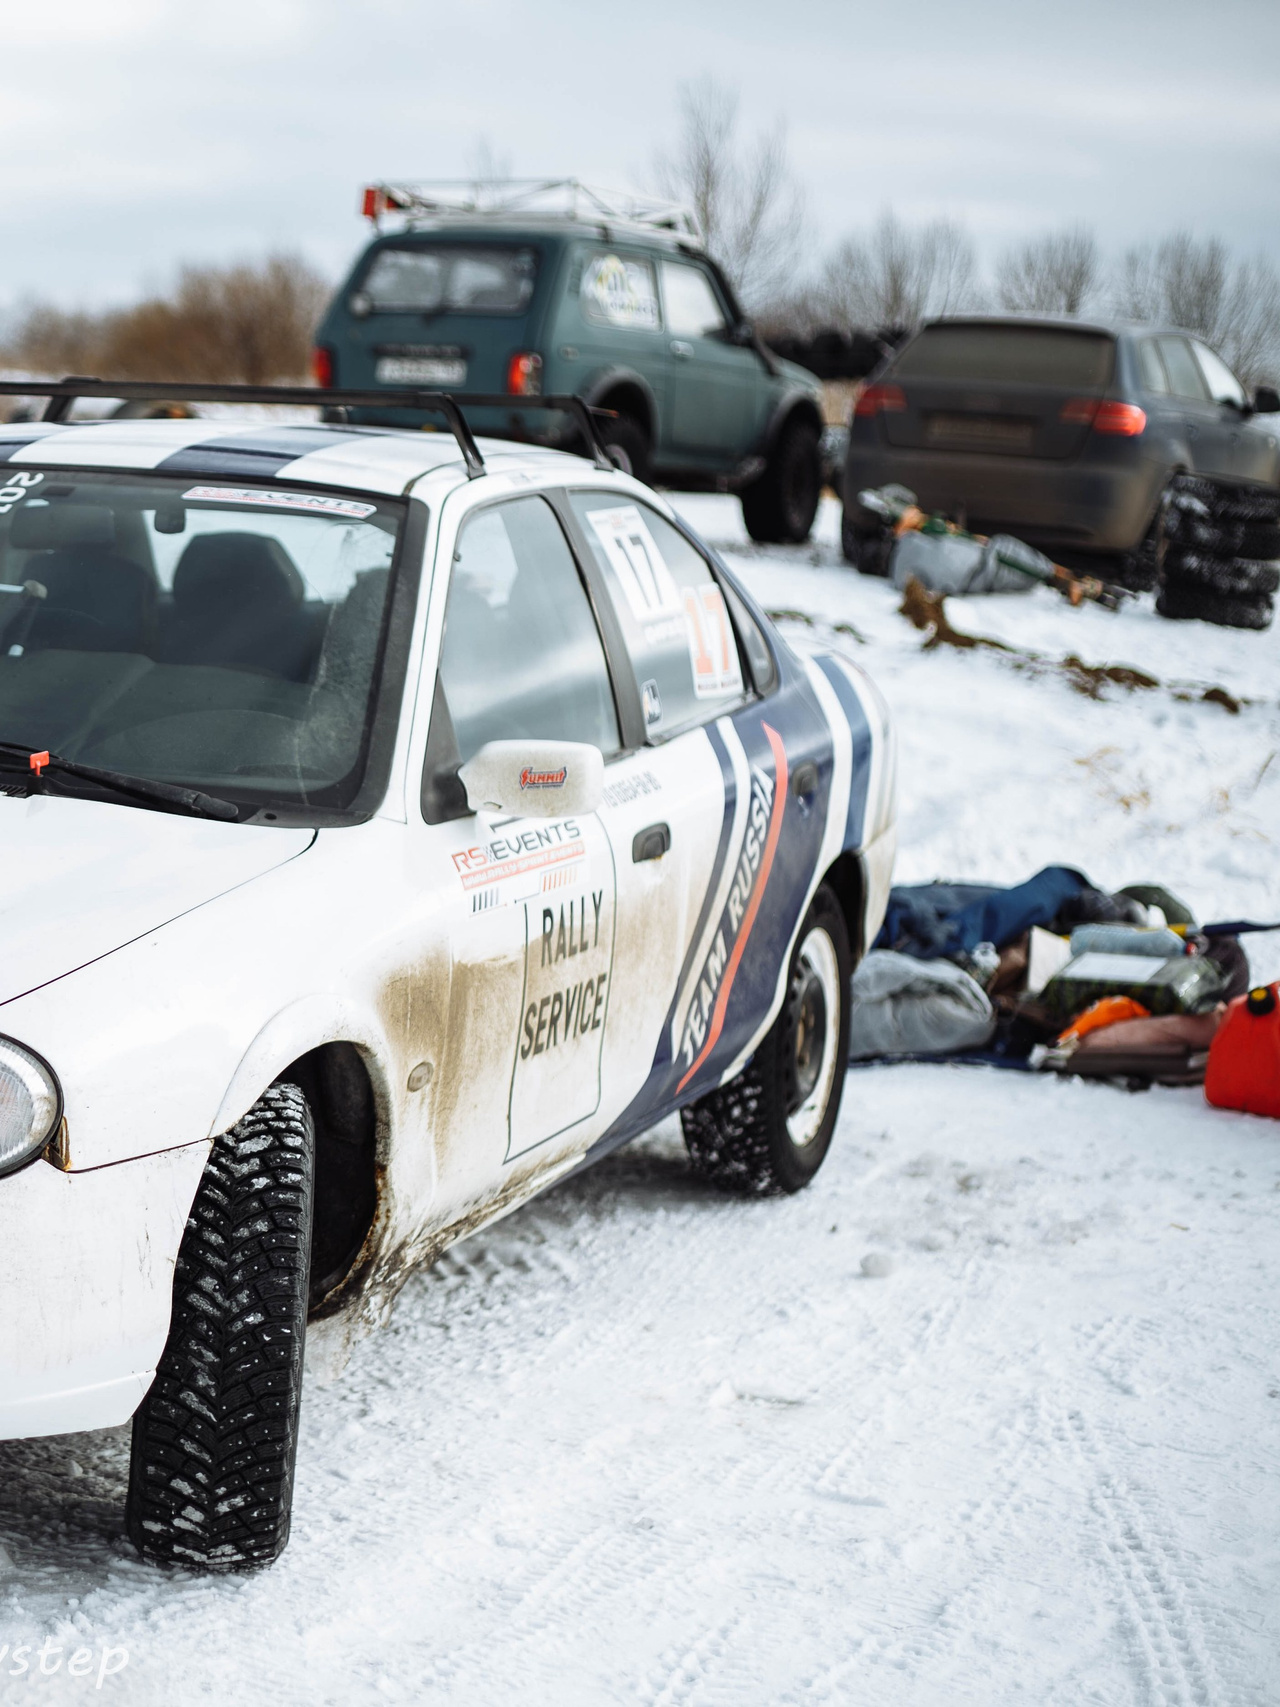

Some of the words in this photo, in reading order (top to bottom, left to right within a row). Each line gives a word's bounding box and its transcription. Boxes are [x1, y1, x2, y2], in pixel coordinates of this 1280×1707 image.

[613, 535, 663, 609] 17
[683, 591, 730, 675] 17
[489, 819, 581, 861] EVENTS
[540, 889, 603, 968] RALLY
[682, 928, 728, 1068] TEAM
[728, 763, 774, 933] RUSSIA
[520, 972, 608, 1061] SERVICE
